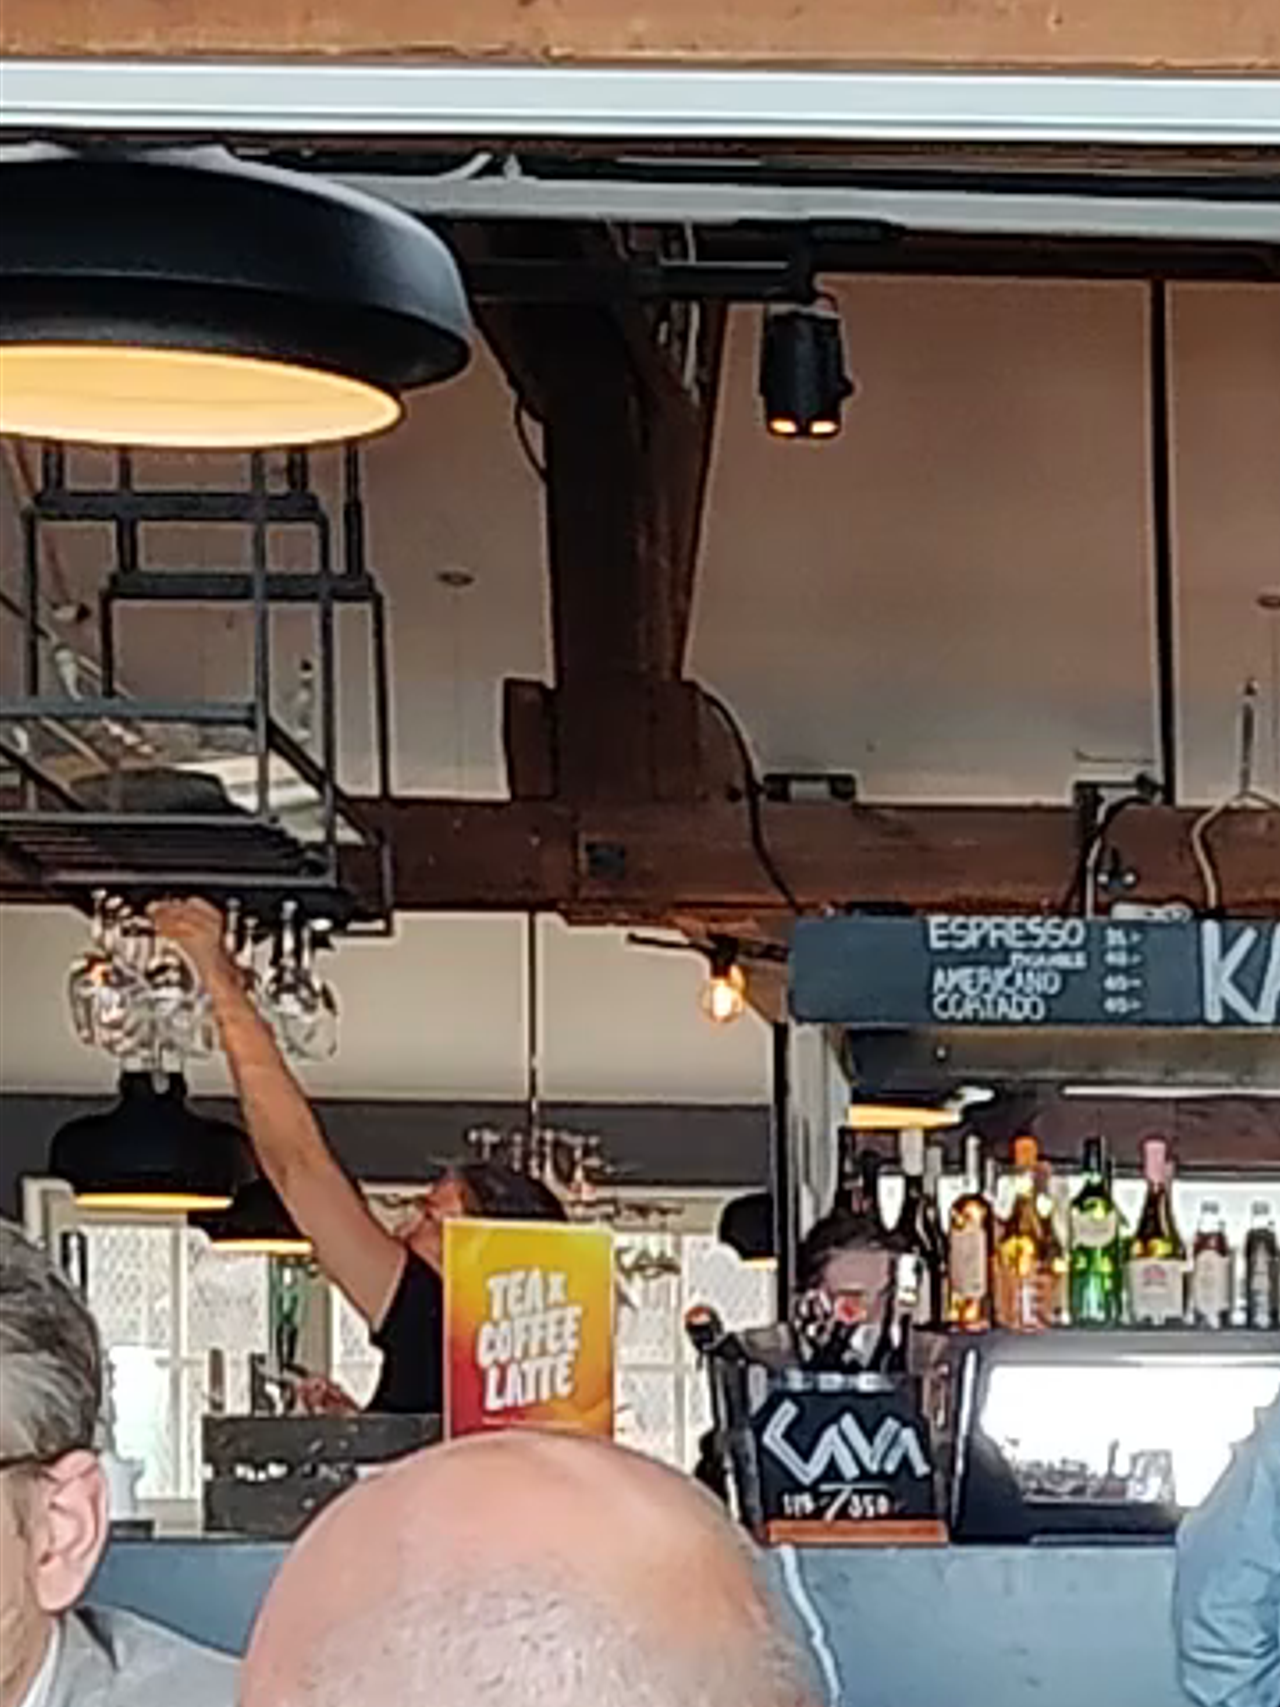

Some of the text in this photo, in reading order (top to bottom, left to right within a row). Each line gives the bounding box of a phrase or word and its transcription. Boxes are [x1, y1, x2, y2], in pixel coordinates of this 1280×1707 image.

[928, 917, 1085, 949] ESPRESSO
[933, 967, 1061, 994] AMERICANO
[933, 995, 1045, 1020] CORTADO
[488, 1267, 545, 1320] TEA
[478, 1306, 582, 1368] COFFEE
[484, 1351, 575, 1411] LATTE
[763, 1399, 931, 1485] CAVA
